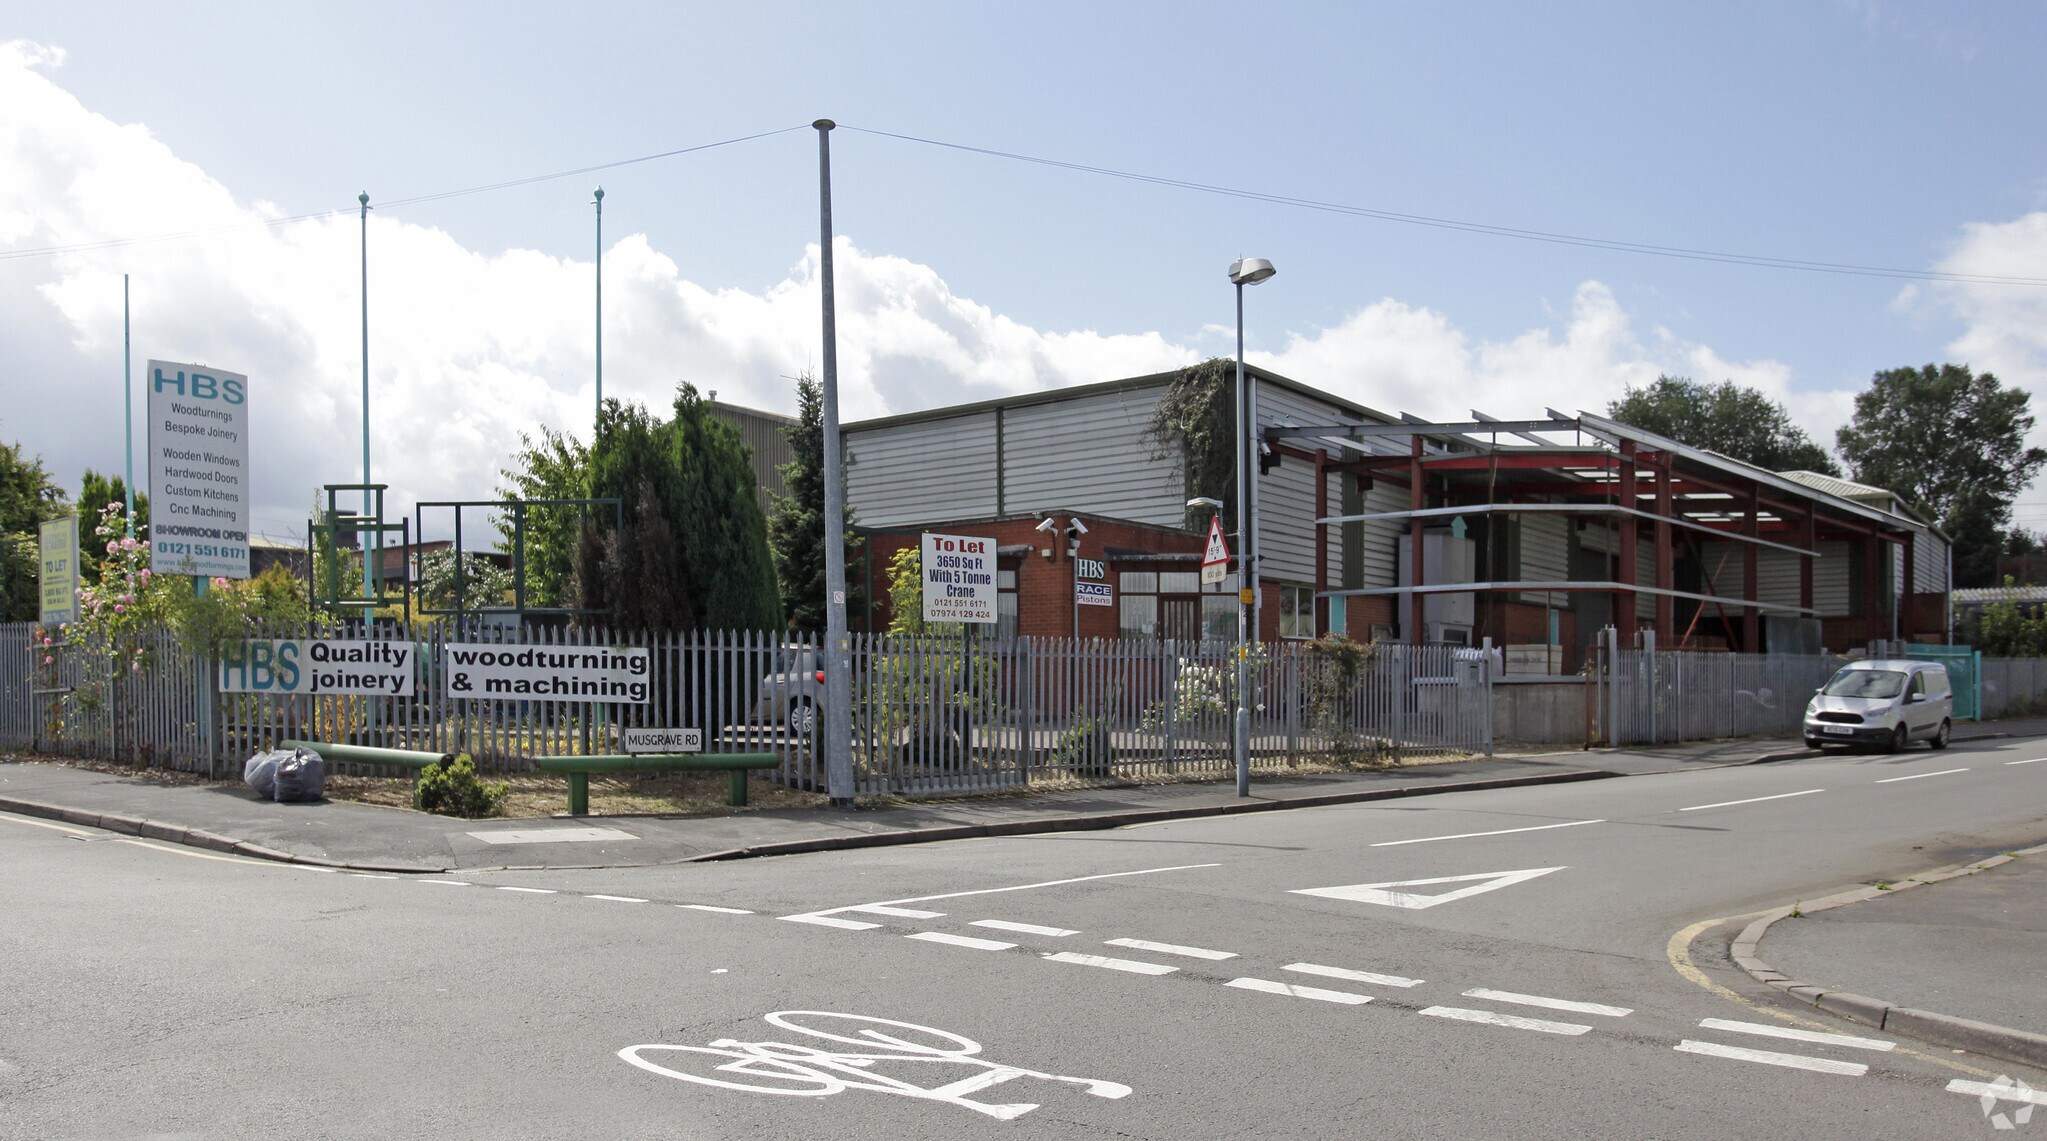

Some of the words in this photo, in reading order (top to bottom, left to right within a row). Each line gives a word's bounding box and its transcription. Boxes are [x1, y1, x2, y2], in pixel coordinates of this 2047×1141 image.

[154, 368, 245, 405] HBS
[171, 402, 233, 423] Woodturnings
[165, 420, 206, 436] Bespoke
[207, 427, 238, 443] Joinery
[163, 447, 202, 462] Wooden
[203, 452, 240, 468] Windows
[165, 466, 213, 481] Hardwood
[214, 471, 239, 485] Doors
[165, 484, 202, 497] Custom
[203, 488, 239, 503] Kitchens
[169, 502, 190, 515] Cnc
[192, 505, 237, 522] Machining
[155, 524, 221, 540] SHOWROOM
[222, 530, 247, 543] OPEN
[158, 541, 191, 555] 0121
[194, 544, 218, 557] 551
[220, 546, 246, 560] 6171
[933, 537, 955, 552] To
[959, 539, 985, 554] Let
[45, 560, 54, 574] TO
[55, 559, 67, 572] LET
[937, 555, 961, 568] 3650
[962, 556, 973, 570] Sq
[975, 558, 983, 569] Ft
[1078, 558, 1105, 580] HBS
[929, 569, 952, 583] With
[954, 570, 961, 583] 5
[962, 571, 991, 585] Tonne
[946, 584, 975, 598] Crane
[1077, 584, 1111, 596] RACE
[1077, 594, 1111, 605] Pistons
[934, 598, 952, 607] 0121
[954, 599, 968, 607] 551
[969, 600, 987, 608] 6171
[931, 609, 956, 617] 07974
[959, 610, 974, 618] 129
[975, 610, 990, 618] 424
[310, 642, 408, 668] Quality
[452, 648, 647, 675] woodturning
[222, 640, 300, 692] HBS
[310, 669, 406, 694] joinery
[451, 672, 474, 691] &
[485, 676, 647, 701] machining
[628, 734, 682, 746] MUSGRAVE
[685, 734, 699, 746] RD
